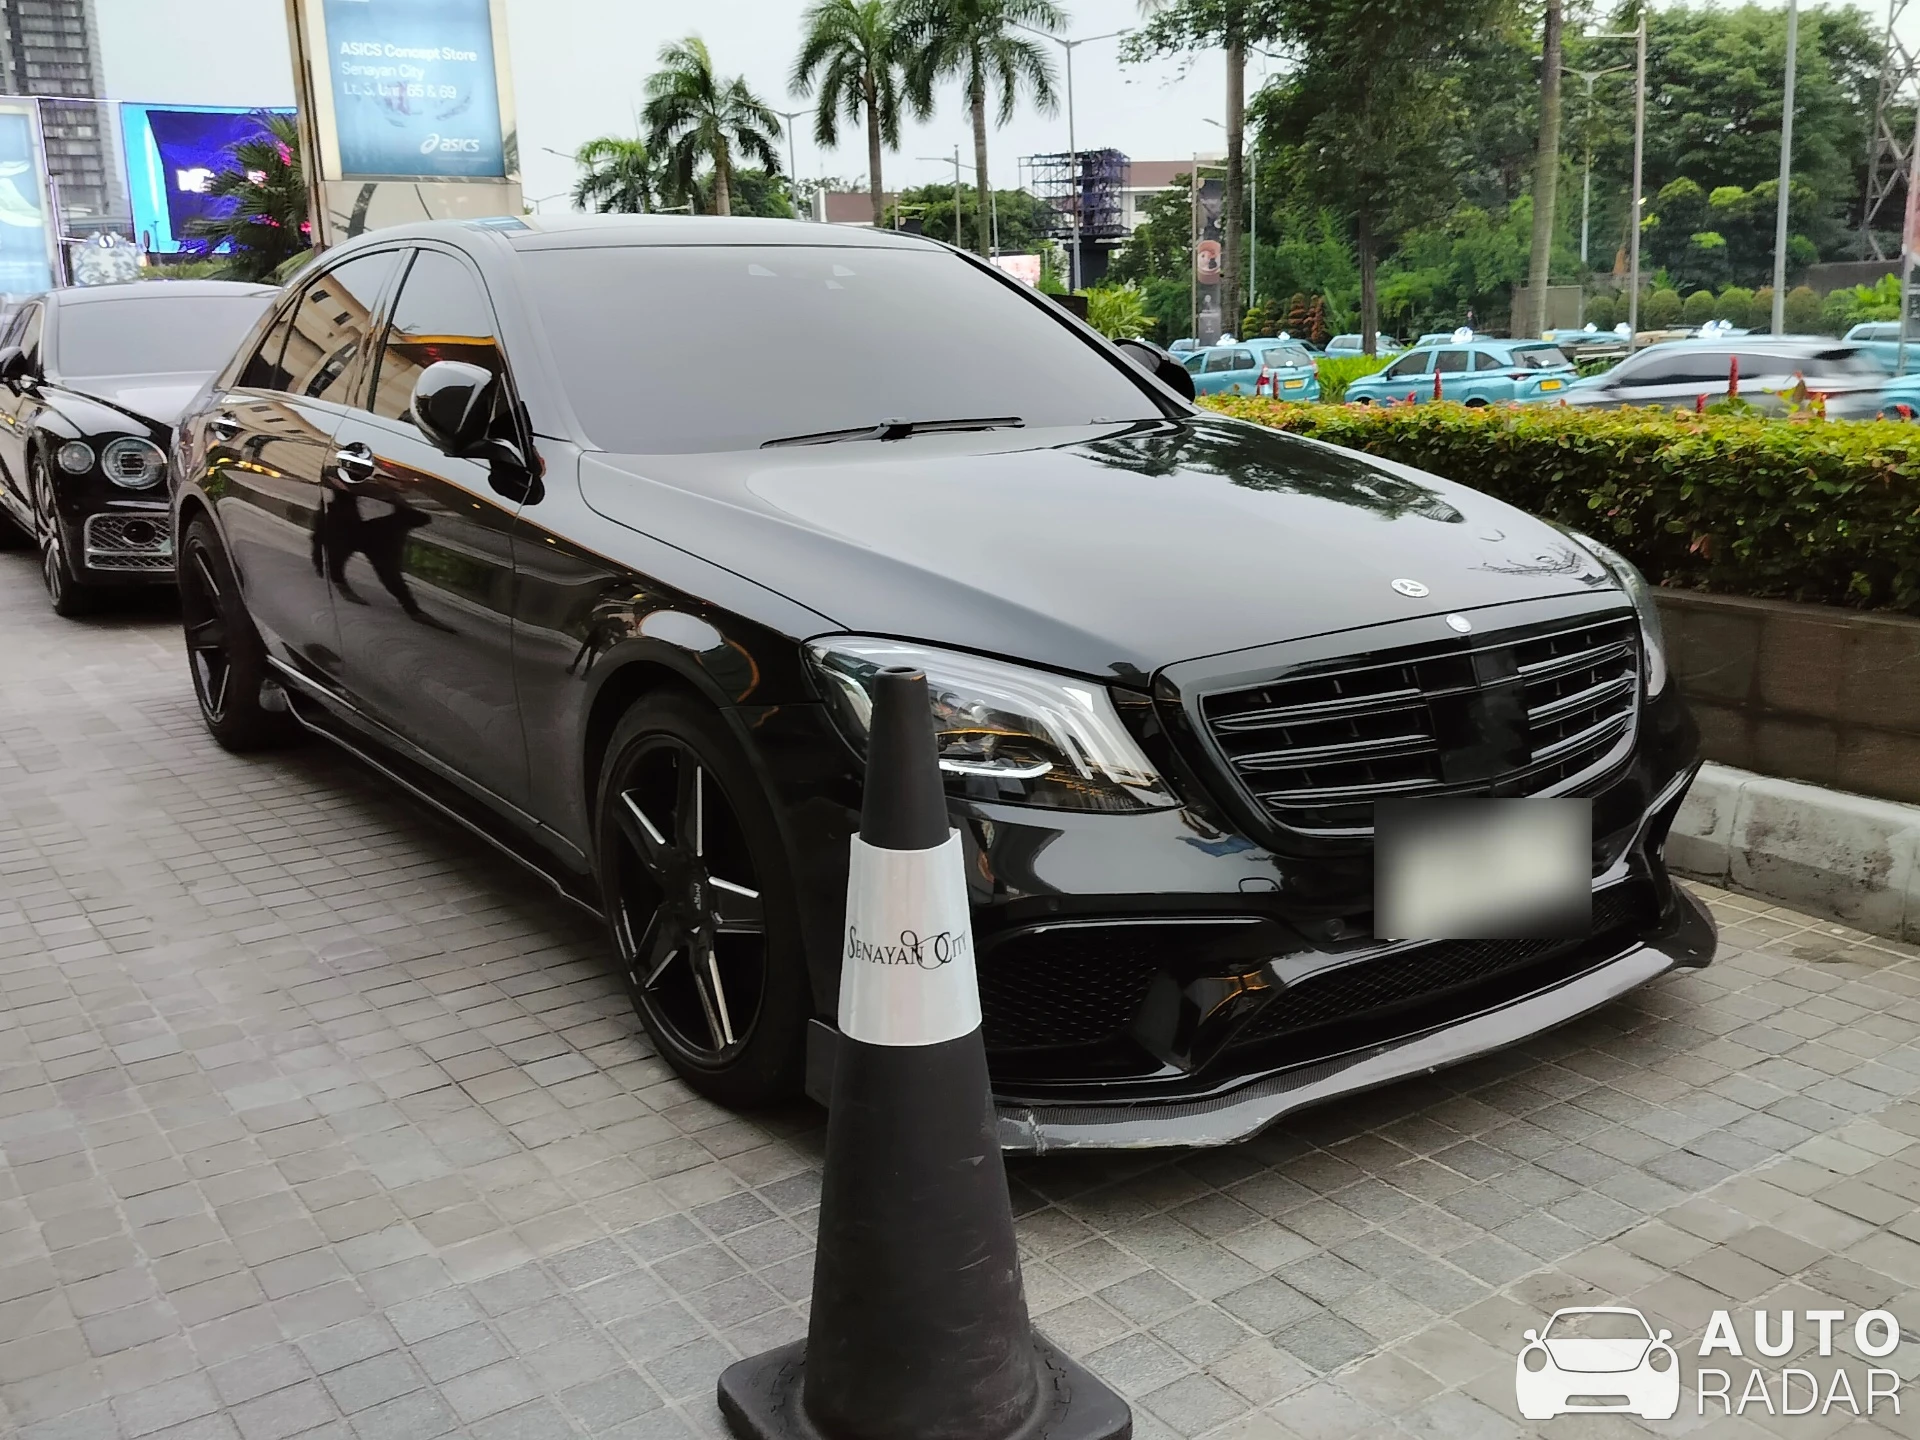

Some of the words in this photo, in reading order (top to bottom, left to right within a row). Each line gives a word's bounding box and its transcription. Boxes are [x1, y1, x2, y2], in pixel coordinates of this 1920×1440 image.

[340, 42, 382, 57] ASICS
[385, 44, 441, 62] Concept
[442, 47, 478, 62] Store
[341, 62, 396, 79] Senayan
[399, 64, 425, 80] City
[406, 85, 424, 97] 65
[427, 86, 439, 98] &
[439, 86, 457, 99] 69
